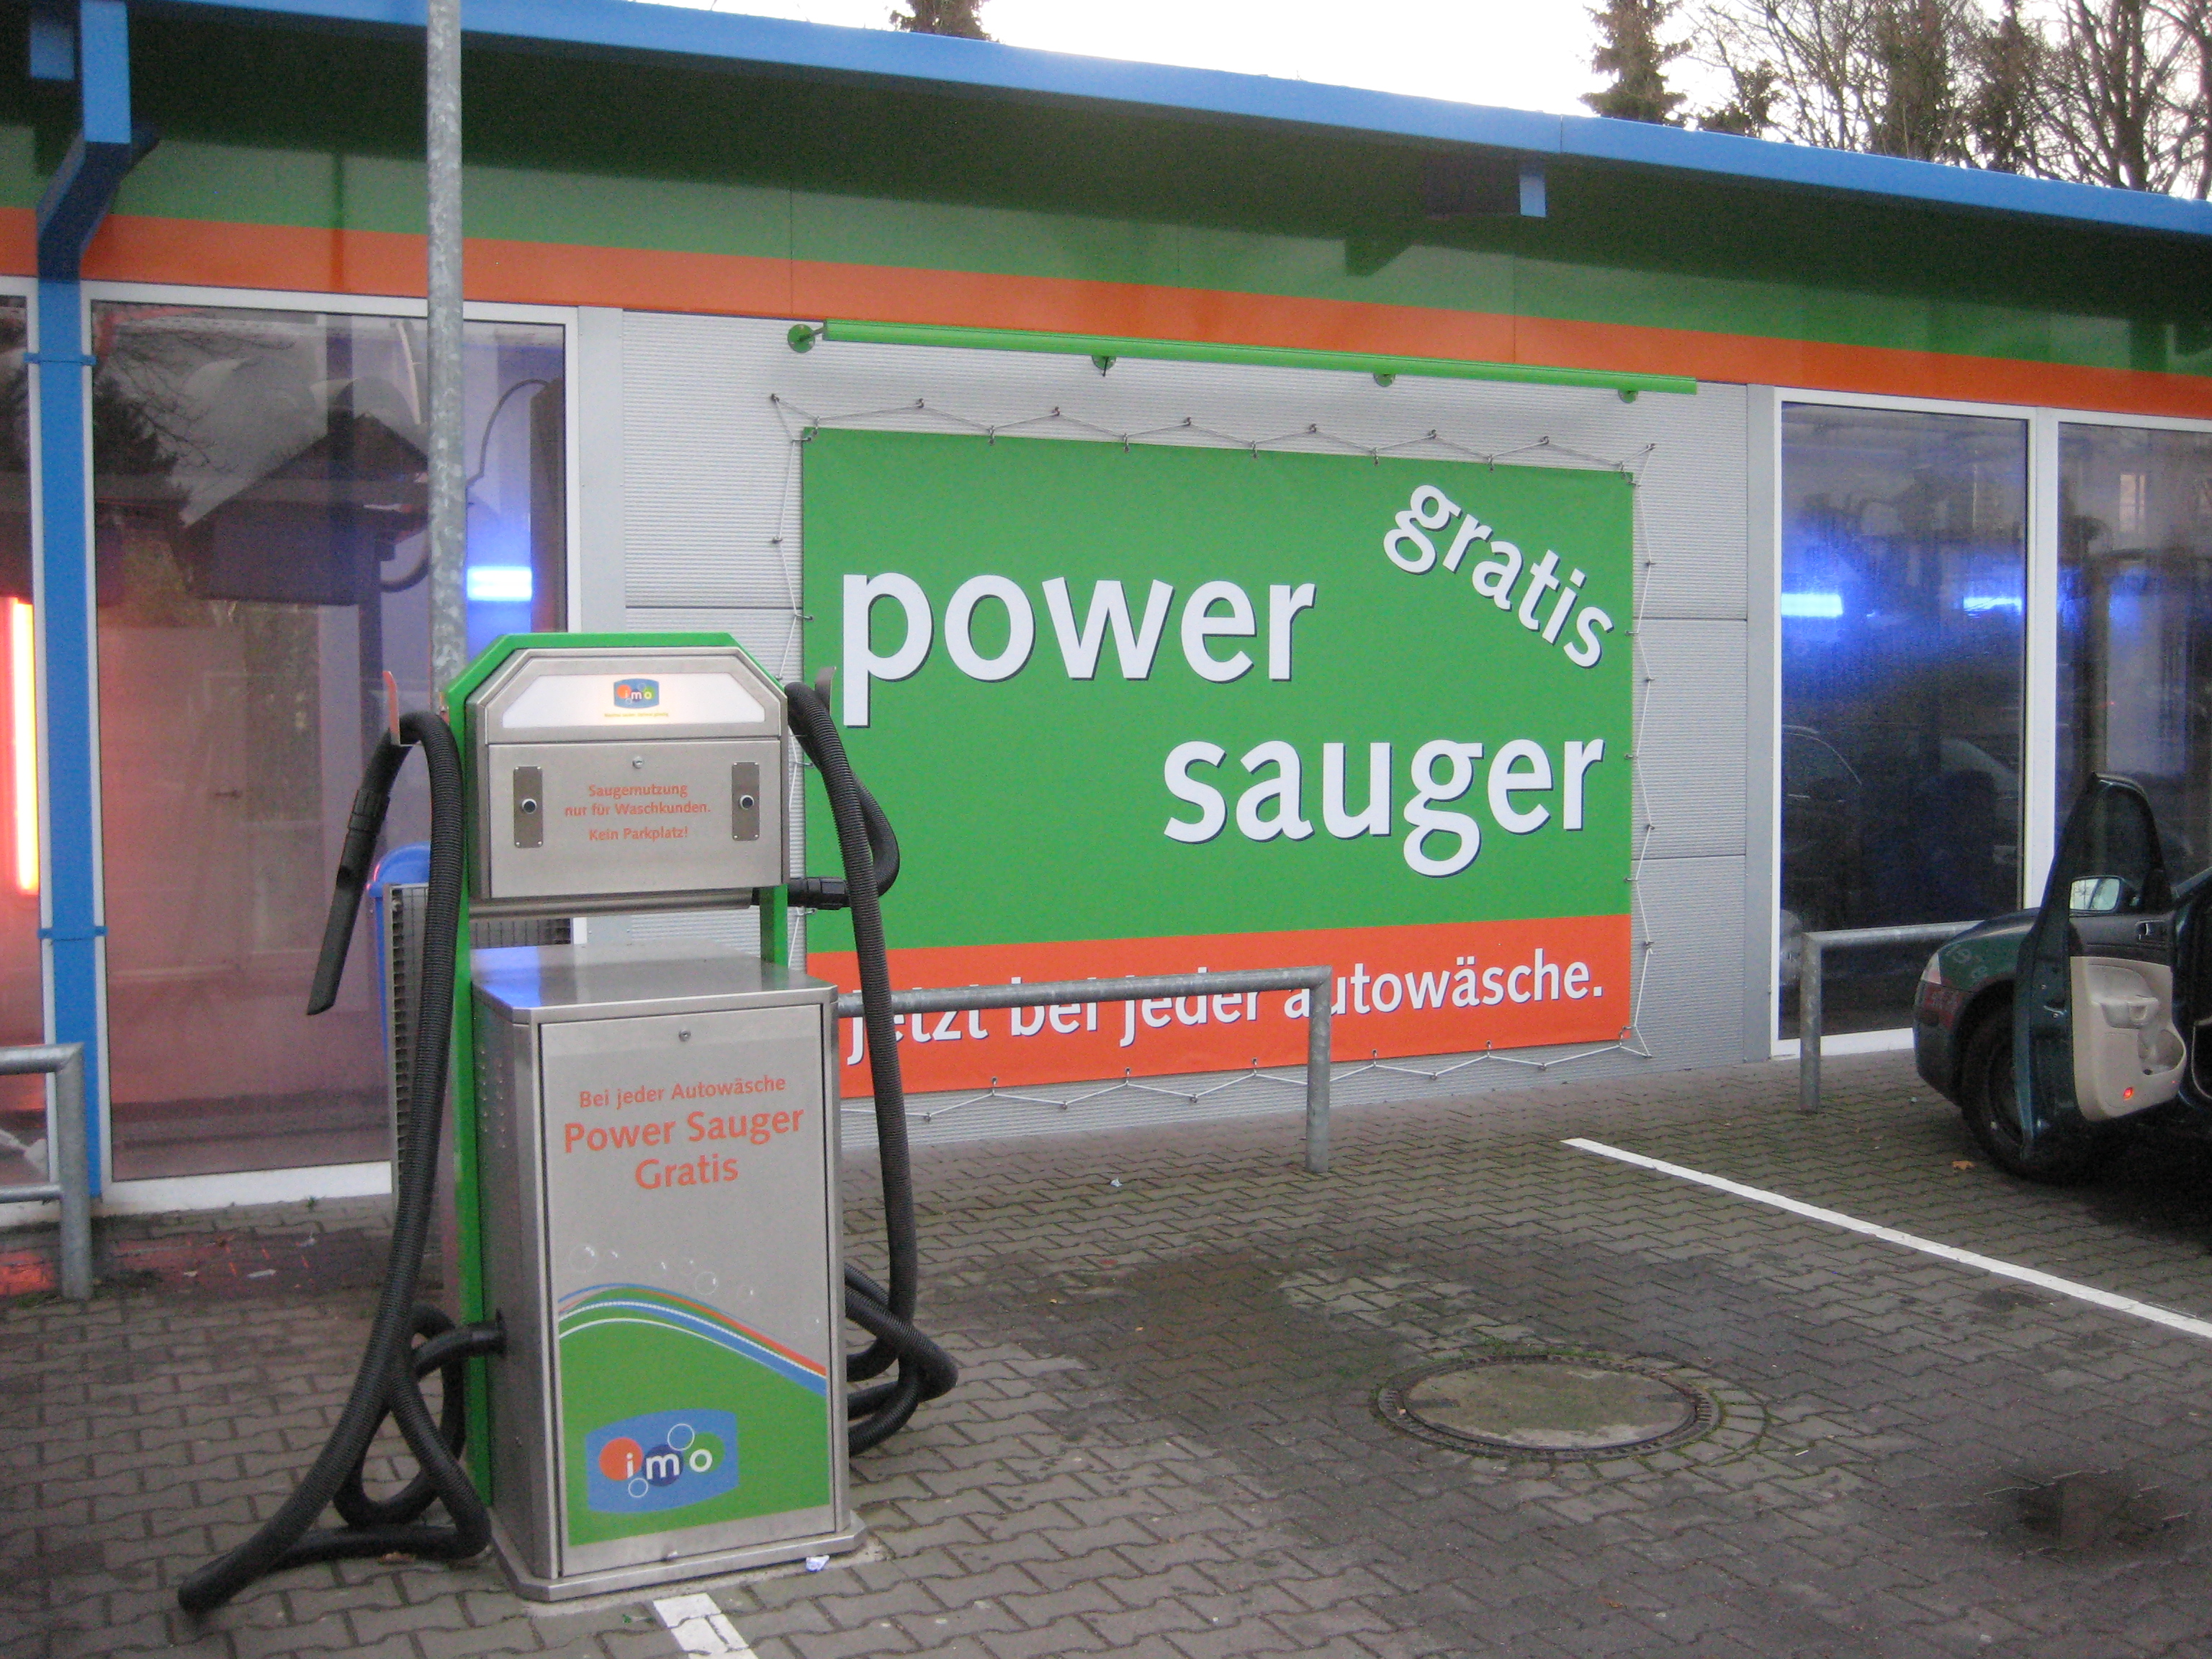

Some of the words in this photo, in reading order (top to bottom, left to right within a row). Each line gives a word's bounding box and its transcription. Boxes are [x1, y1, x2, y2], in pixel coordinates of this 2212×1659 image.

[1383, 484, 1614, 669] gratis
[842, 572, 1316, 727] power
[624, 690, 652, 700] imo
[565, 806, 587, 817] nur
[592, 803, 611, 816] für
[614, 801, 711, 815] Waschkunden.
[588, 783, 688, 799] Saugernutzung
[1163, 738, 1604, 878] sauger
[589, 829, 619, 841] Kein
[623, 826, 689, 842] Parkplatz!
[579, 1089, 609, 1109] Bei
[616, 1084, 665, 1110] jeder
[670, 1074, 786, 1100] Autowäsche
[564, 1120, 676, 1154] Power
[686, 1109, 805, 1146] Sauger
[634, 1153, 739, 1190] Gratis
[626, 1448, 713, 1480] imo
